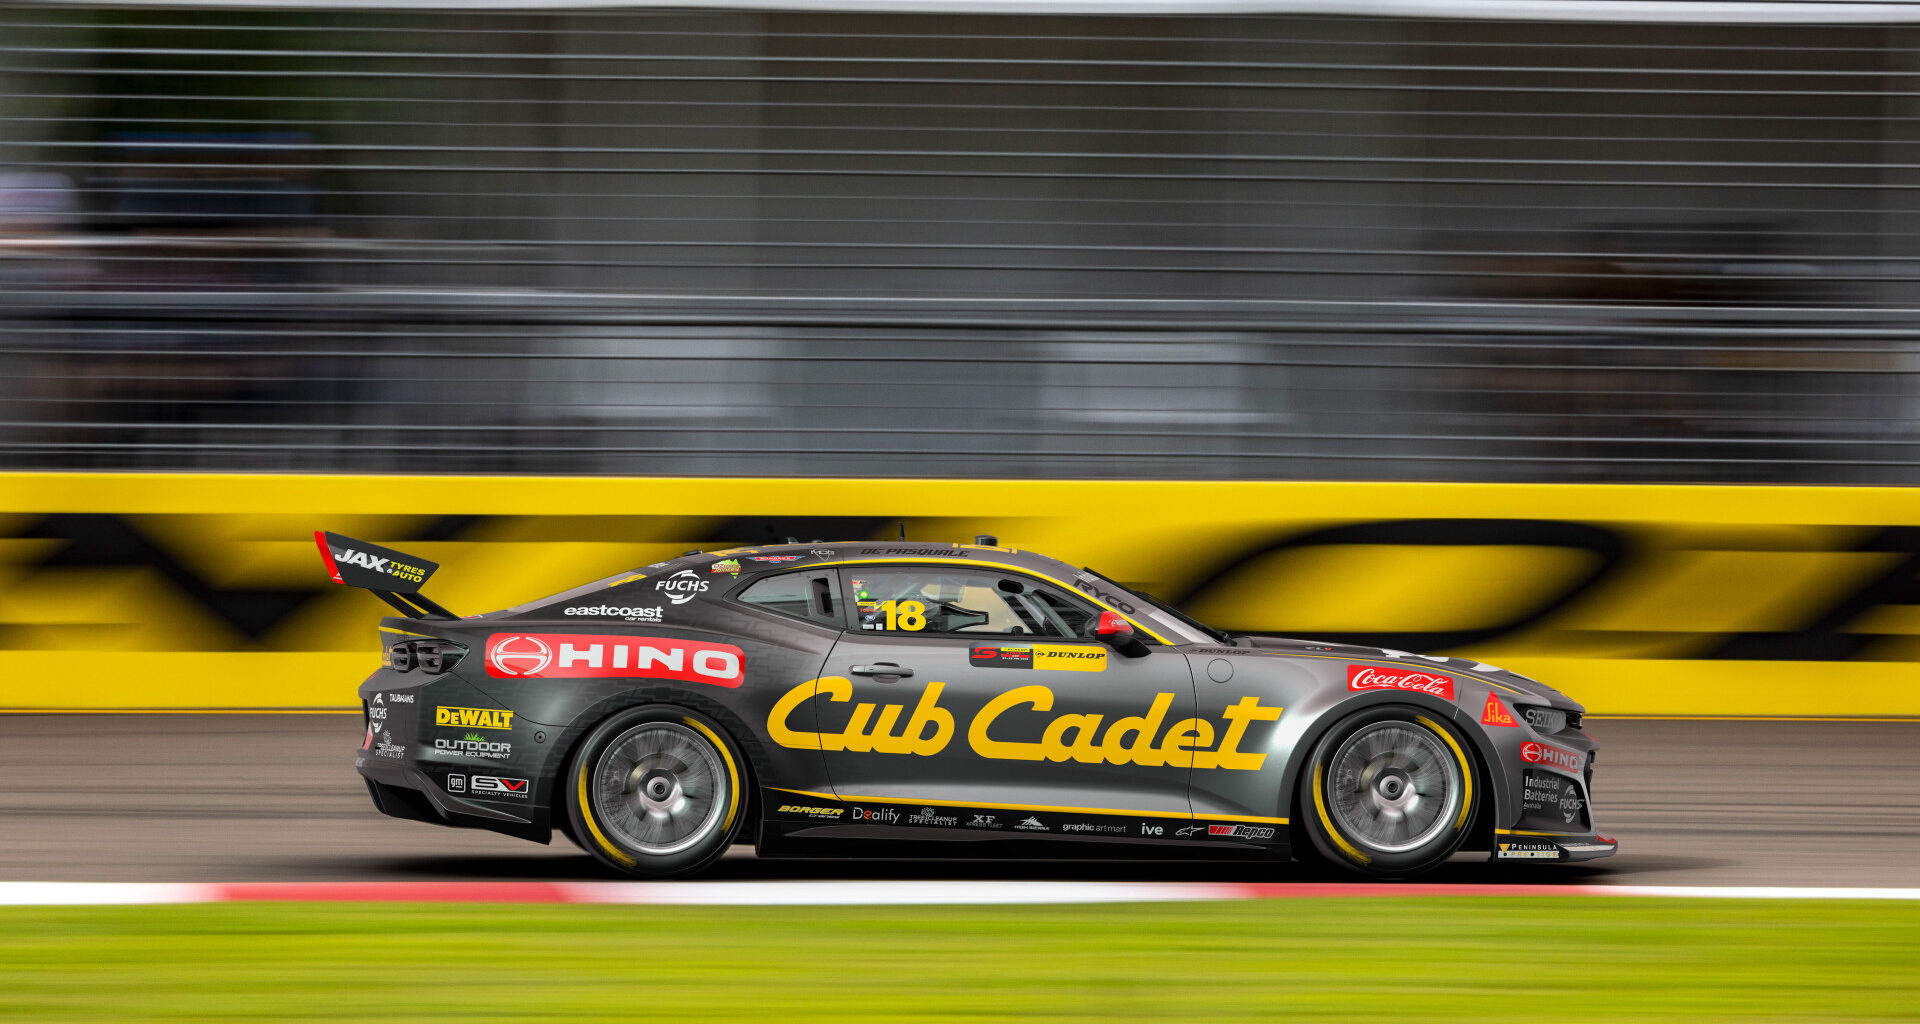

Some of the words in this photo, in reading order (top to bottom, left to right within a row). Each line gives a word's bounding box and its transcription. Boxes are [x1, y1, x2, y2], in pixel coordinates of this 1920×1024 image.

[885, 548, 971, 558] PASQUALE
[334, 548, 391, 573] JAX
[390, 561, 426, 576] TYRES
[392, 570, 422, 583] AUTO
[655, 580, 709, 592] FUCHS
[1073, 579, 1135, 614] RYCO
[564, 605, 664, 618] eastcoast
[881, 600, 927, 631] 18
[558, 643, 740, 679] HINO
[1046, 651, 1105, 659] DUNLOP
[1351, 668, 1448, 695] Coca-Cola
[389, 693, 415, 704] TAUBMANS
[370, 707, 388, 720] FUCHS
[1484, 702, 1512, 723] Sika
[766, 676, 955, 756] Cub
[968, 685, 1284, 770] Cadet
[435, 739, 511, 753] OUTDOOR
[375, 749, 405, 759] SPECIALIST
[465, 751, 511, 759] EQUIPMENT
[1543, 748, 1578, 770] HINO
[450, 777, 463, 788] gm
[1525, 776, 1560, 790] Industrial
[1524, 789, 1558, 803] Batteries
[778, 805, 844, 815] BORGER
[1560, 798, 1584, 810] FUCHS
[852, 807, 901, 824] Dealify
[973, 814, 996, 823] XF
[908, 819, 958, 827] SPECIALIST
[1062, 824, 1095, 832] graphic
[1107, 825, 1128, 833] mart
[1141, 823, 1164, 835] ive
[1232, 825, 1276, 839] Repco
[1511, 843, 1558, 851] PENINSULA
